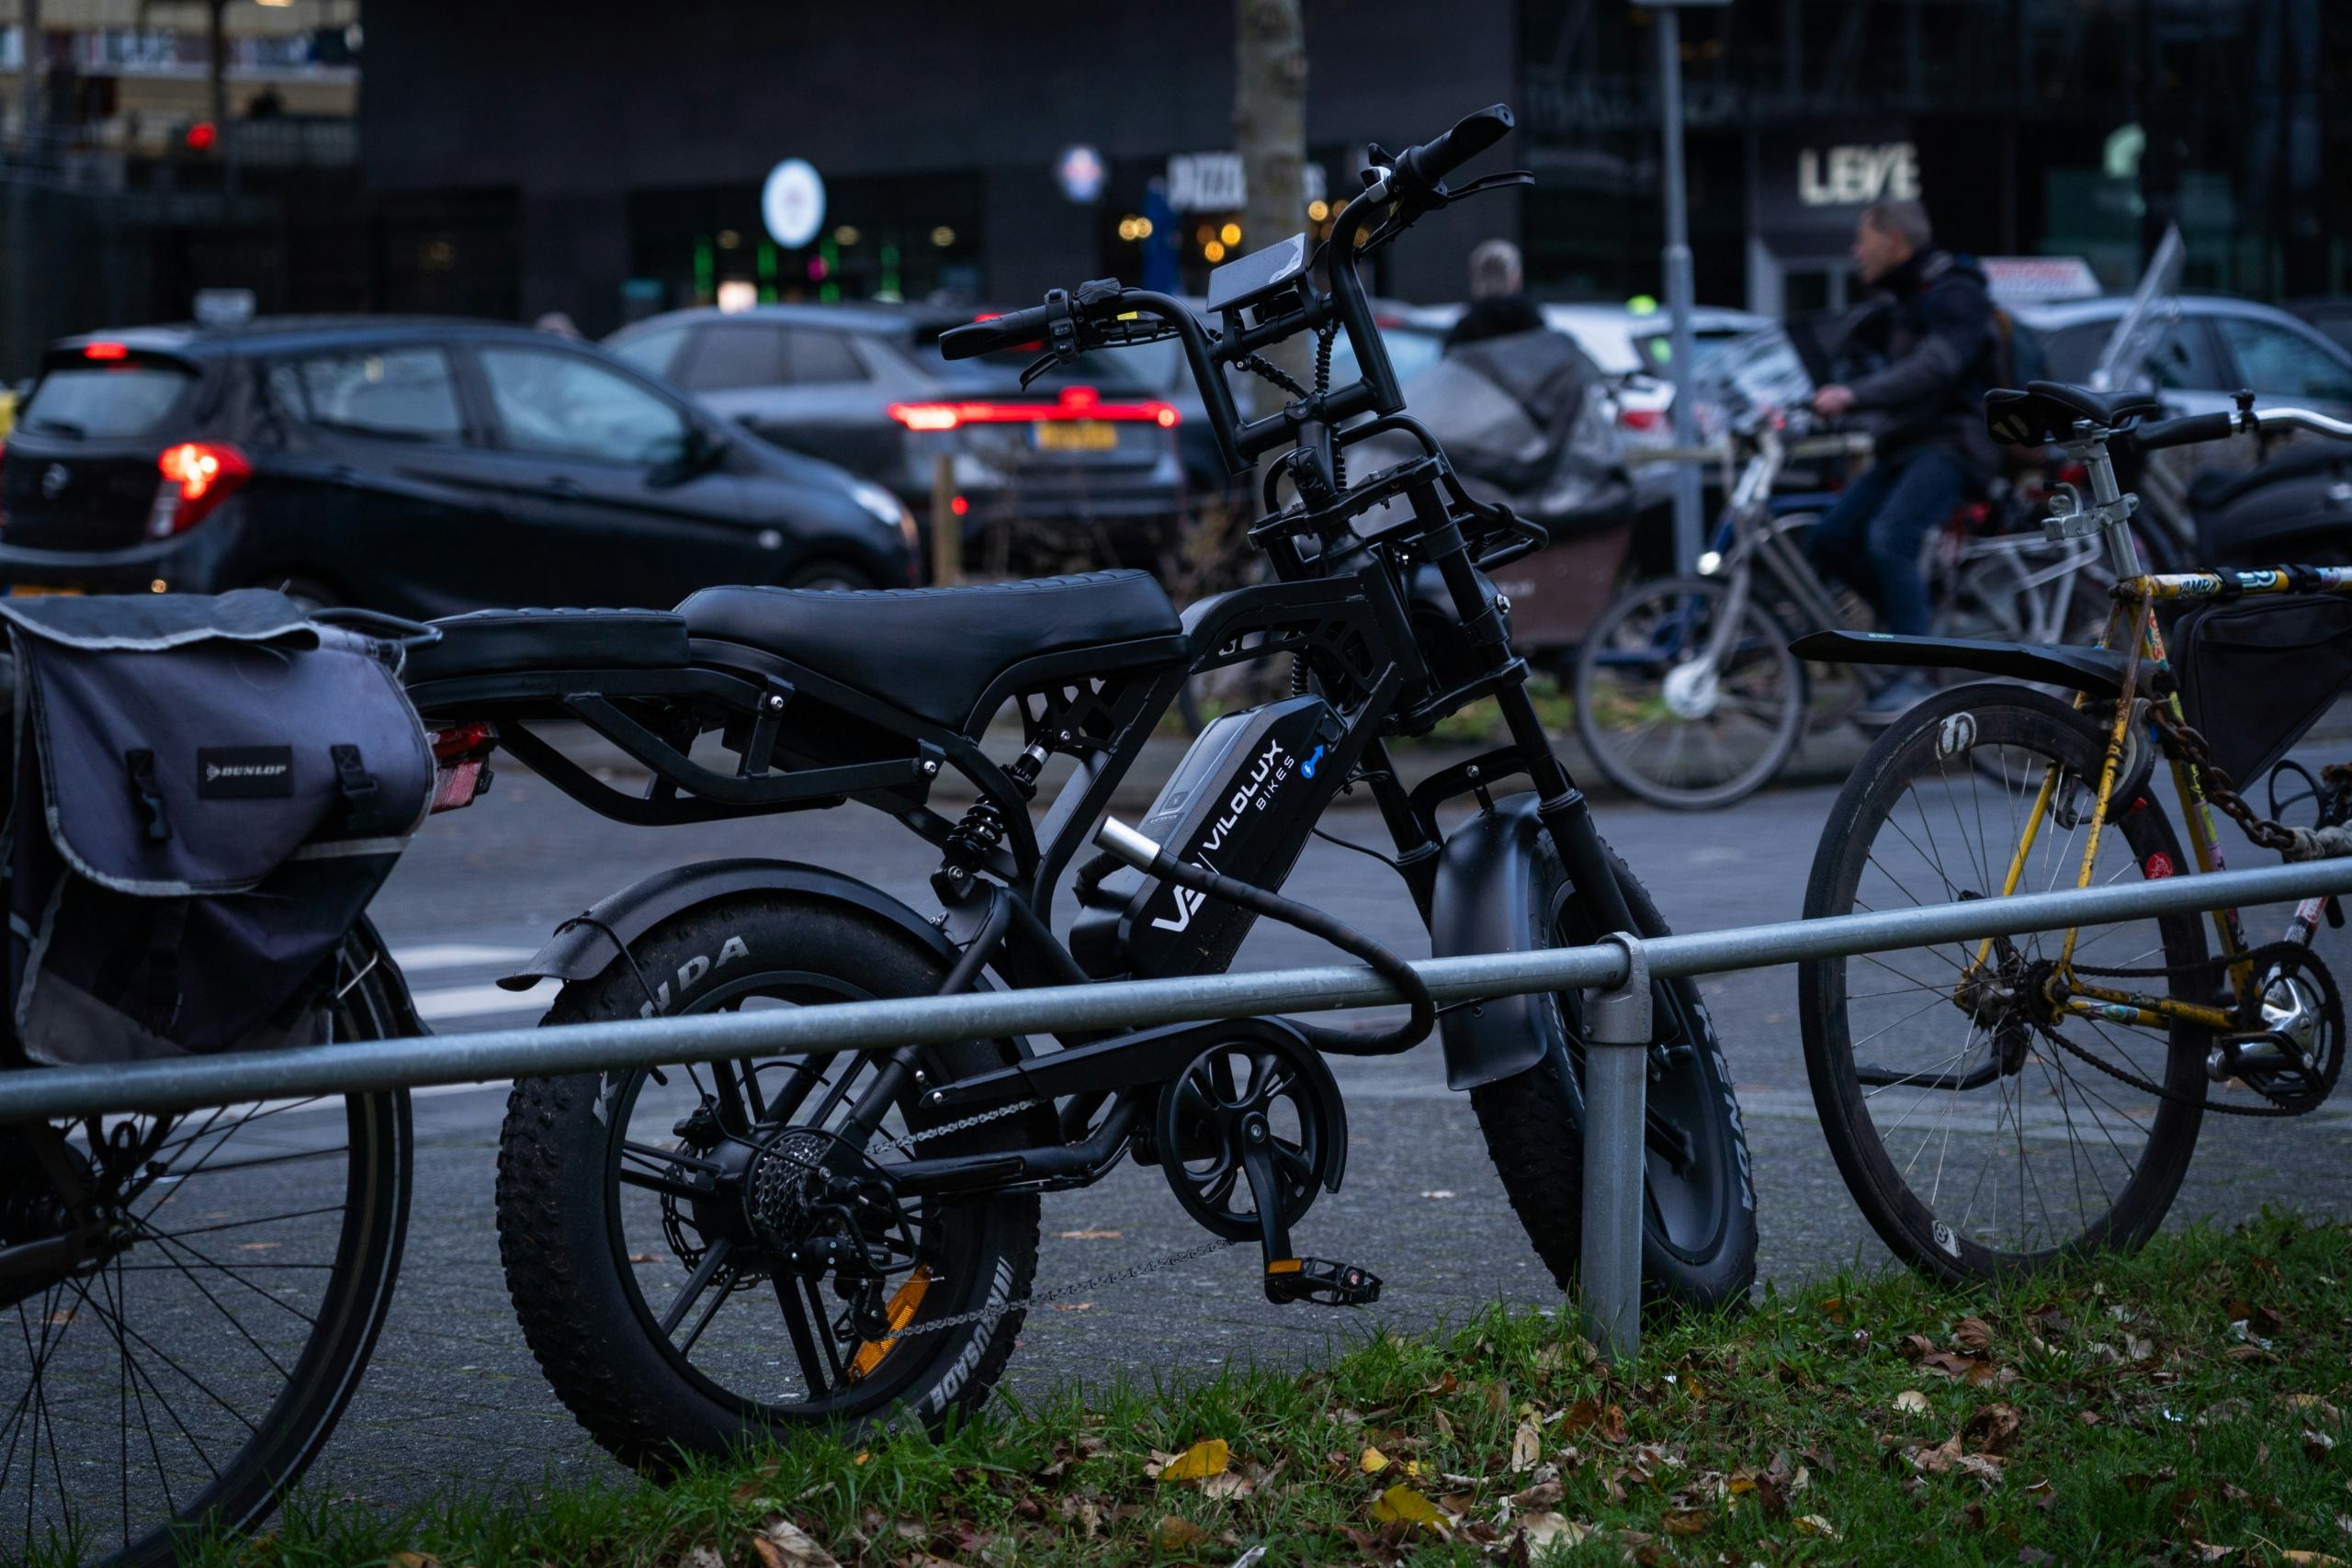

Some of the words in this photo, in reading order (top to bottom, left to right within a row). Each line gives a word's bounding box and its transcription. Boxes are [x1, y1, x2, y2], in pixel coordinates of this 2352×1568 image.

[221, 764, 288, 776] DUNLOP
[1203, 739, 1283, 852] VILOLUX
[1255, 755, 1295, 811] BIKES
[1693, 1004, 1754, 1212] KENDA
